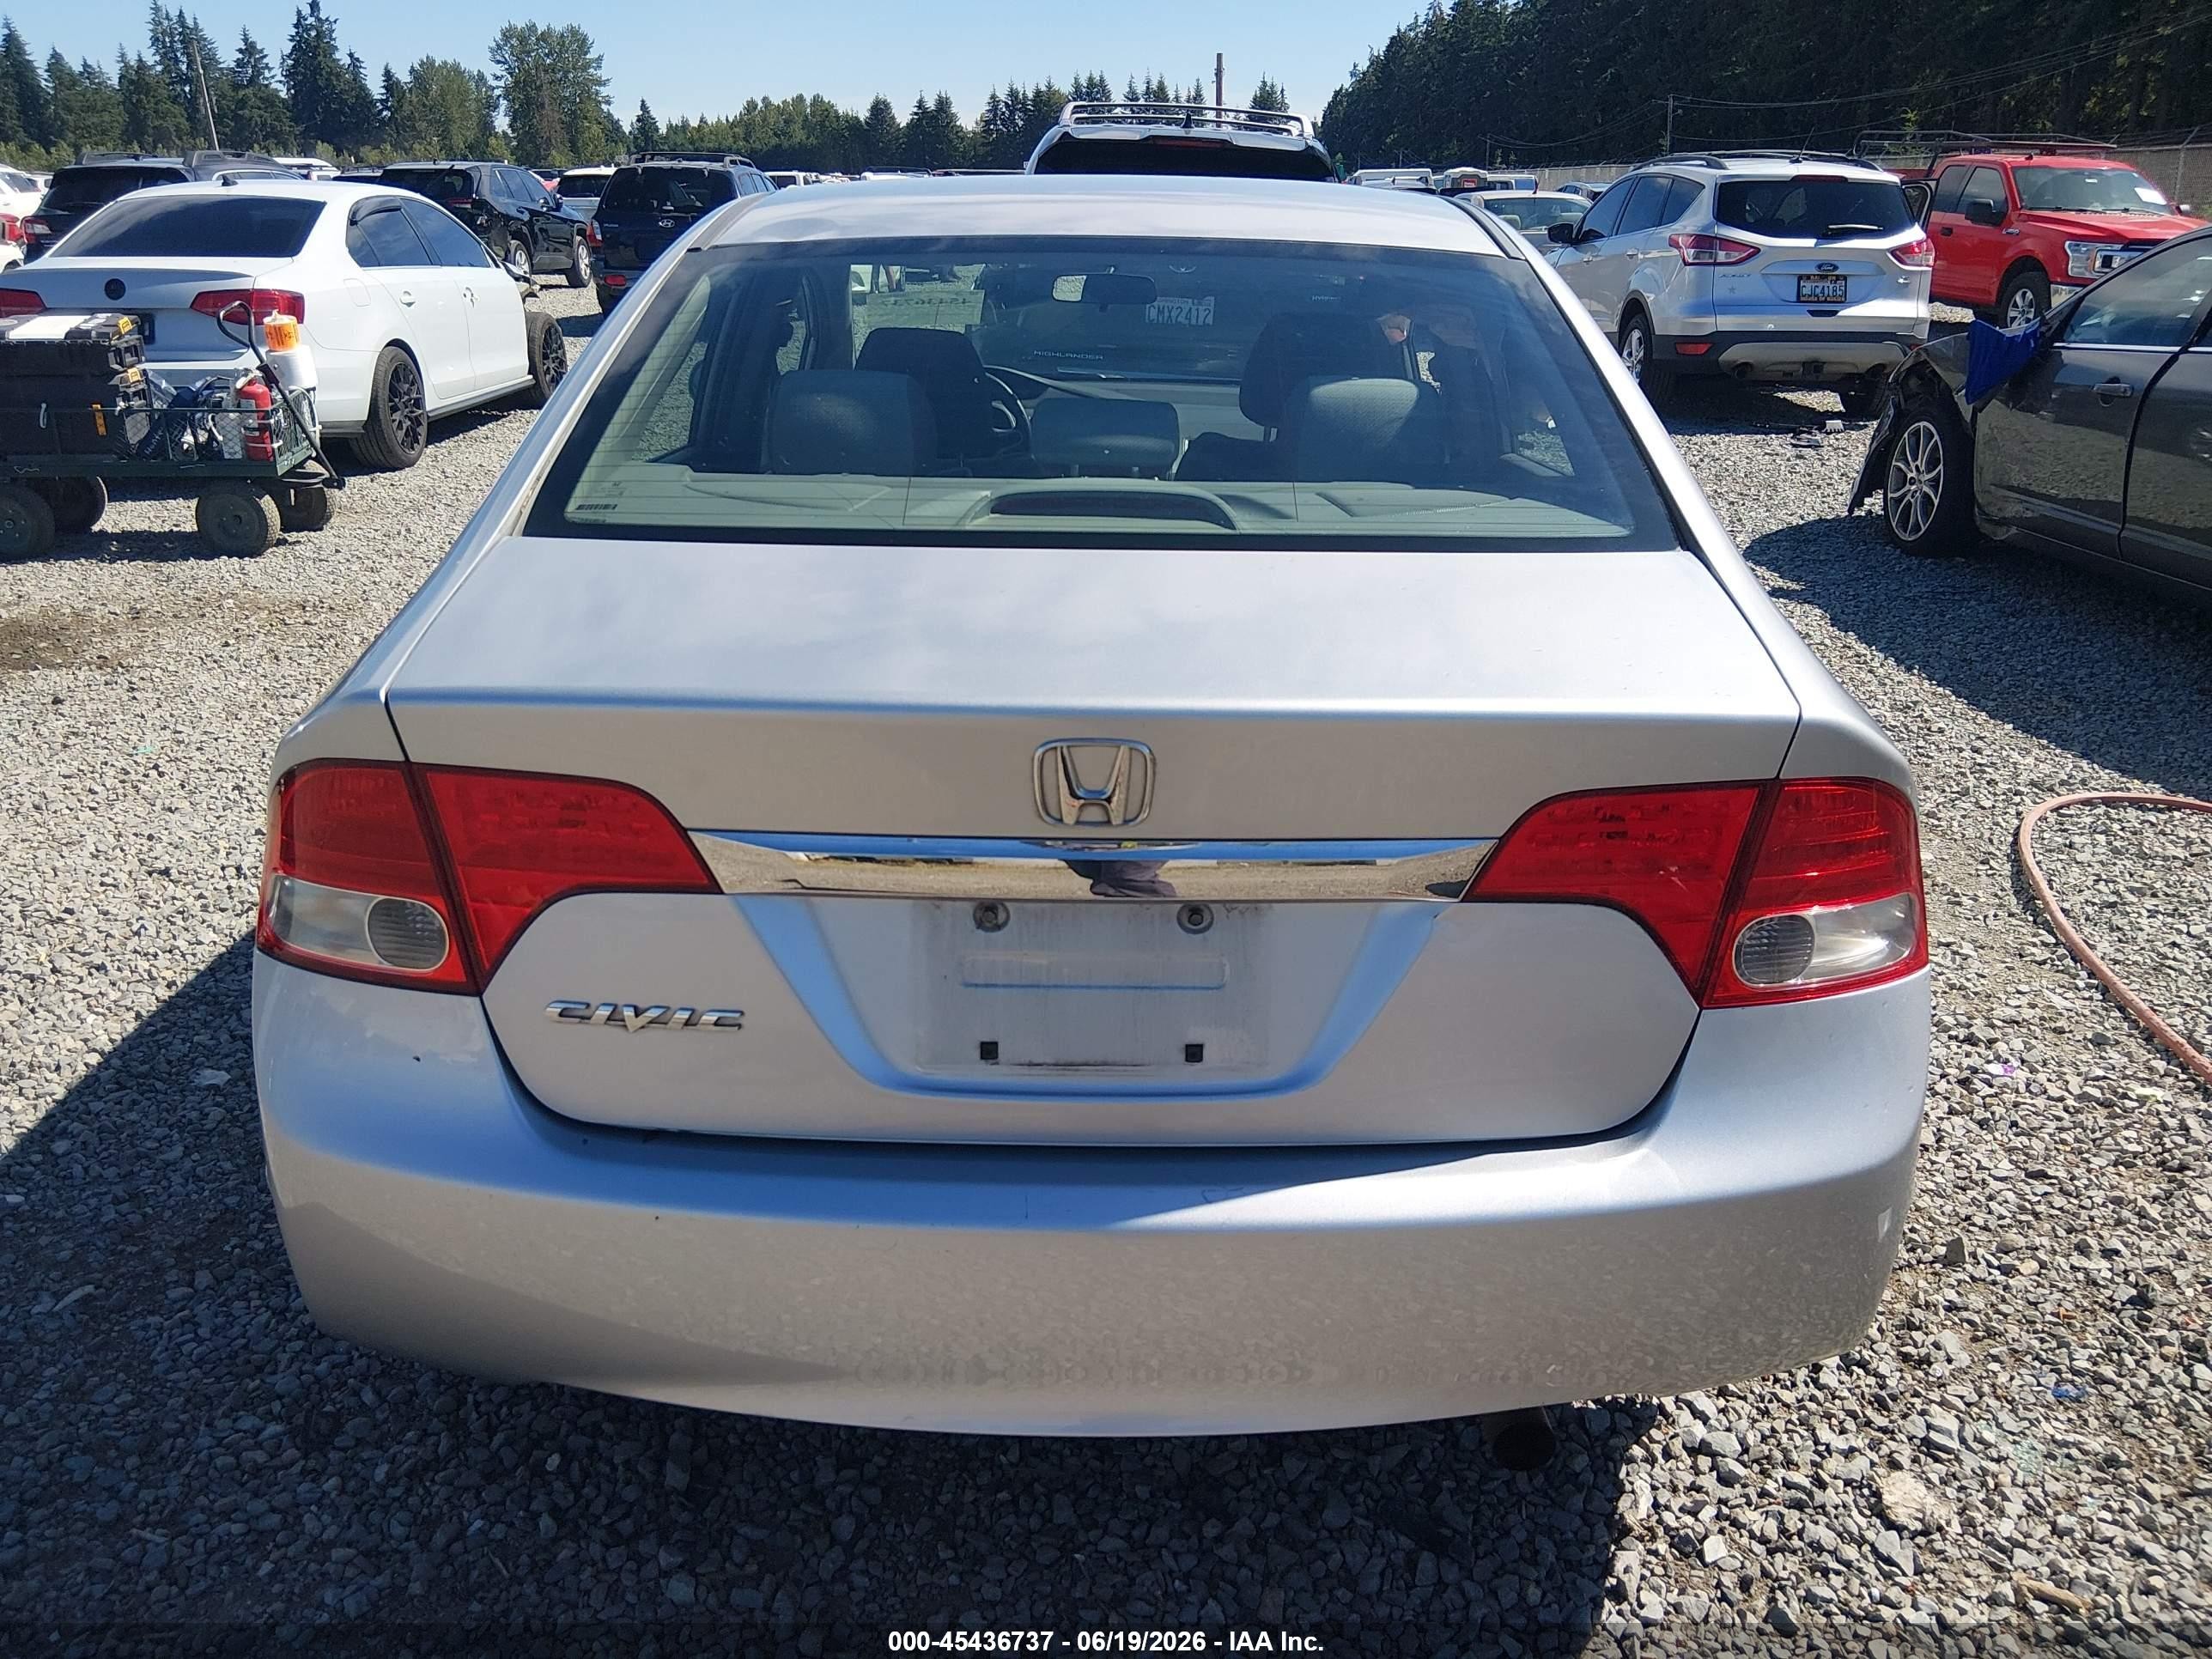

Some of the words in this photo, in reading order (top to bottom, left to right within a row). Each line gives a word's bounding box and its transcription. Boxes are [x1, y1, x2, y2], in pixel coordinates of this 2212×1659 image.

[1801, 285, 1844, 298] CJC4185
[1033, 349, 1104, 360] HIGHLANDER
[545, 1000, 744, 1032] CIVIC
